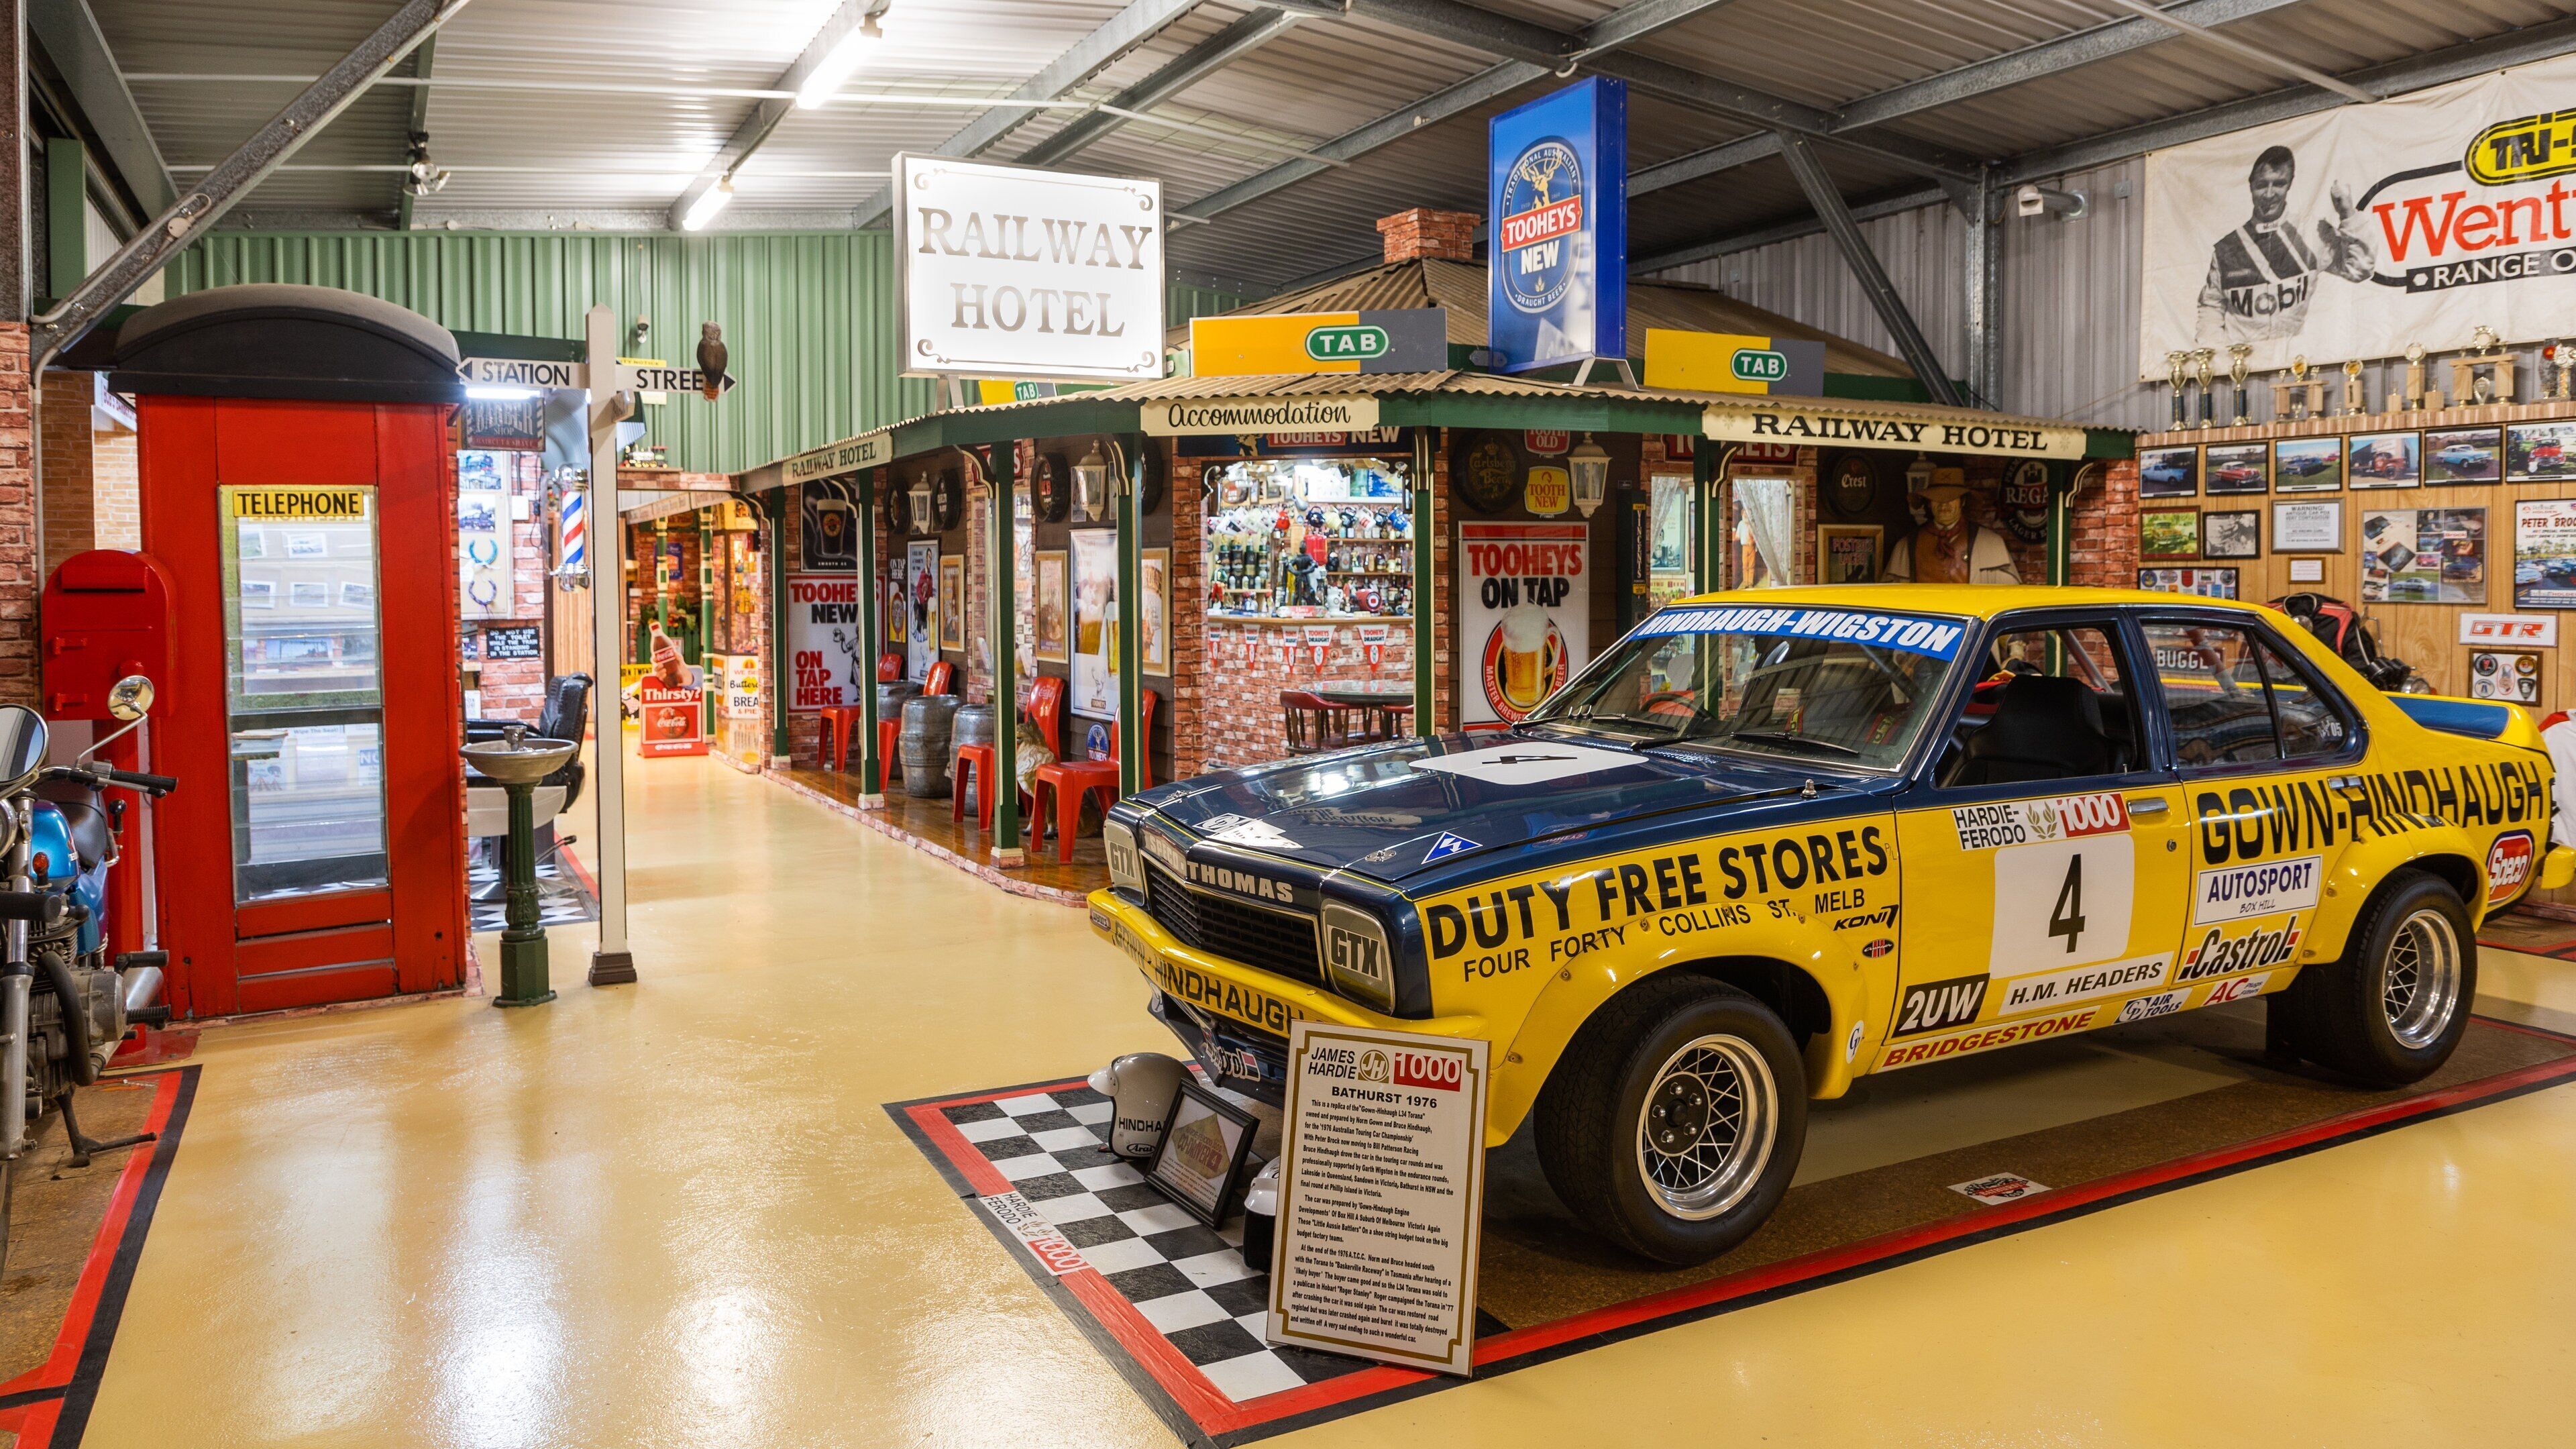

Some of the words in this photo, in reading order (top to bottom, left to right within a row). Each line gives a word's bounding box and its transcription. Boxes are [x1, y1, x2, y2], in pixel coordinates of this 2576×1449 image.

[2489, 127, 2576, 171] TRI-
[1506, 203, 1576, 245] TOOHEYS
[2372, 178, 2576, 262] Went
[918, 207, 1152, 270] RAILWAY
[1521, 239, 1560, 275] NEW
[2432, 253, 2540, 288] RANGE
[1517, 294, 1546, 307] DRAUGHT
[1548, 284, 1564, 302] BEER
[2231, 275, 2309, 317] Mobil
[950, 282, 1125, 337] HOTEL
[1319, 333, 1377, 354] TAB
[482, 361, 570, 386] STATION
[1740, 356, 1780, 374] TAB
[637, 368, 704, 390] STREE
[1016, 382, 1036, 399] TAB
[475, 400, 534, 435] BARBER
[1168, 401, 1350, 428] Accommodation
[494, 427, 515, 435] SHOP
[1351, 426, 1400, 443] NEW
[1536, 436, 1558, 448] OLD
[1752, 413, 1929, 443] RAILWAY
[1941, 425, 2048, 450] HOTEL
[792, 451, 836, 478] RAILWAY
[839, 441, 877, 467] HOTEL
[1529, 484, 1566, 496] TOOTH
[1841, 473, 1867, 489] Crest
[237, 493, 360, 515] TELEPHONE
[1534, 496, 1558, 508] NEW
[2521, 518, 2548, 528] PETER
[890, 559, 898, 570] ON
[897, 559, 906, 570] TAP
[1467, 543, 1582, 576] TOOHEYS
[891, 568, 904, 579] HERE
[1481, 577, 1519, 609] ON
[1523, 577, 1570, 607] TAP
[811, 604, 858, 624] NEW
[1638, 608, 1962, 652] HINDHAUGH-WIGSTON
[2469, 621, 2547, 638] GTR
[796, 651, 822, 669] ON
[796, 669, 832, 687] TAP
[1485, 665, 1500, 704] MASTER
[1556, 663, 1565, 688] BEER
[644, 688, 702, 702] Thirsty?
[796, 687, 843, 706] HERE
[657, 716, 687, 728] Coca-Cola
[1953, 804, 2019, 829] HARDIE-
[2057, 794, 2121, 831] 1000
[2197, 761, 2544, 865] GOWN-HINDHAUGH
[1959, 824, 2026, 850] FERODO
[1110, 842, 1136, 879] GTX
[2489, 848, 2528, 891] Speco
[1426, 875, 1572, 961] DUTY
[1593, 853, 1707, 922] FREE
[1719, 826, 1888, 900] STORES
[2208, 863, 2312, 903] AUTOSPORT
[2048, 853, 2086, 954] 4
[2240, 902, 2257, 914] BOX
[2258, 900, 2276, 910] HILL
[1833, 904, 1899, 932] KONI
[1463, 948, 1531, 983] FOUR
[1550, 926, 1625, 962] FORTY
[1658, 905, 1752, 936] COLLINS
[1766, 899, 1796, 919] ST.
[1815, 888, 1865, 914] MELB
[2190, 916, 2297, 979] Castrol
[1331, 927, 1381, 979] GTX
[2010, 982, 2057, 1006] H.M.
[2065, 962, 2163, 996] HEADERS
[2203, 977, 2250, 1006] AC
[1898, 981, 1985, 1032] 2UW
[2145, 1002, 2183, 1018] TOOLS
[2151, 994, 2174, 1007] AIR
[1882, 1011, 2096, 1068] BRIDGESTONE
[1307, 1062, 1357, 1080] HARDIE
[1311, 1046, 1355, 1064] JAMES
[1395, 1053, 1461, 1083] 1000
[1332, 1085, 1402, 1104] BATHURST
[1406, 1095, 1437, 1108] 1976
[1349, 1115, 1355, 1124] by
[1356, 1116, 1368, 1124] Norm
[1368, 1118, 1383, 1126] Gown
[1393, 1121, 1406, 1129] Bruce
[1407, 1122, 1432, 1134] Hindhaugh,
[1132, 1143, 1153, 1153] Arai
[983, 1196, 1021, 1224] FERODO
[1002, 1193, 1038, 1219] HARDIE
[1034, 1236, 1086, 1268] 1000
